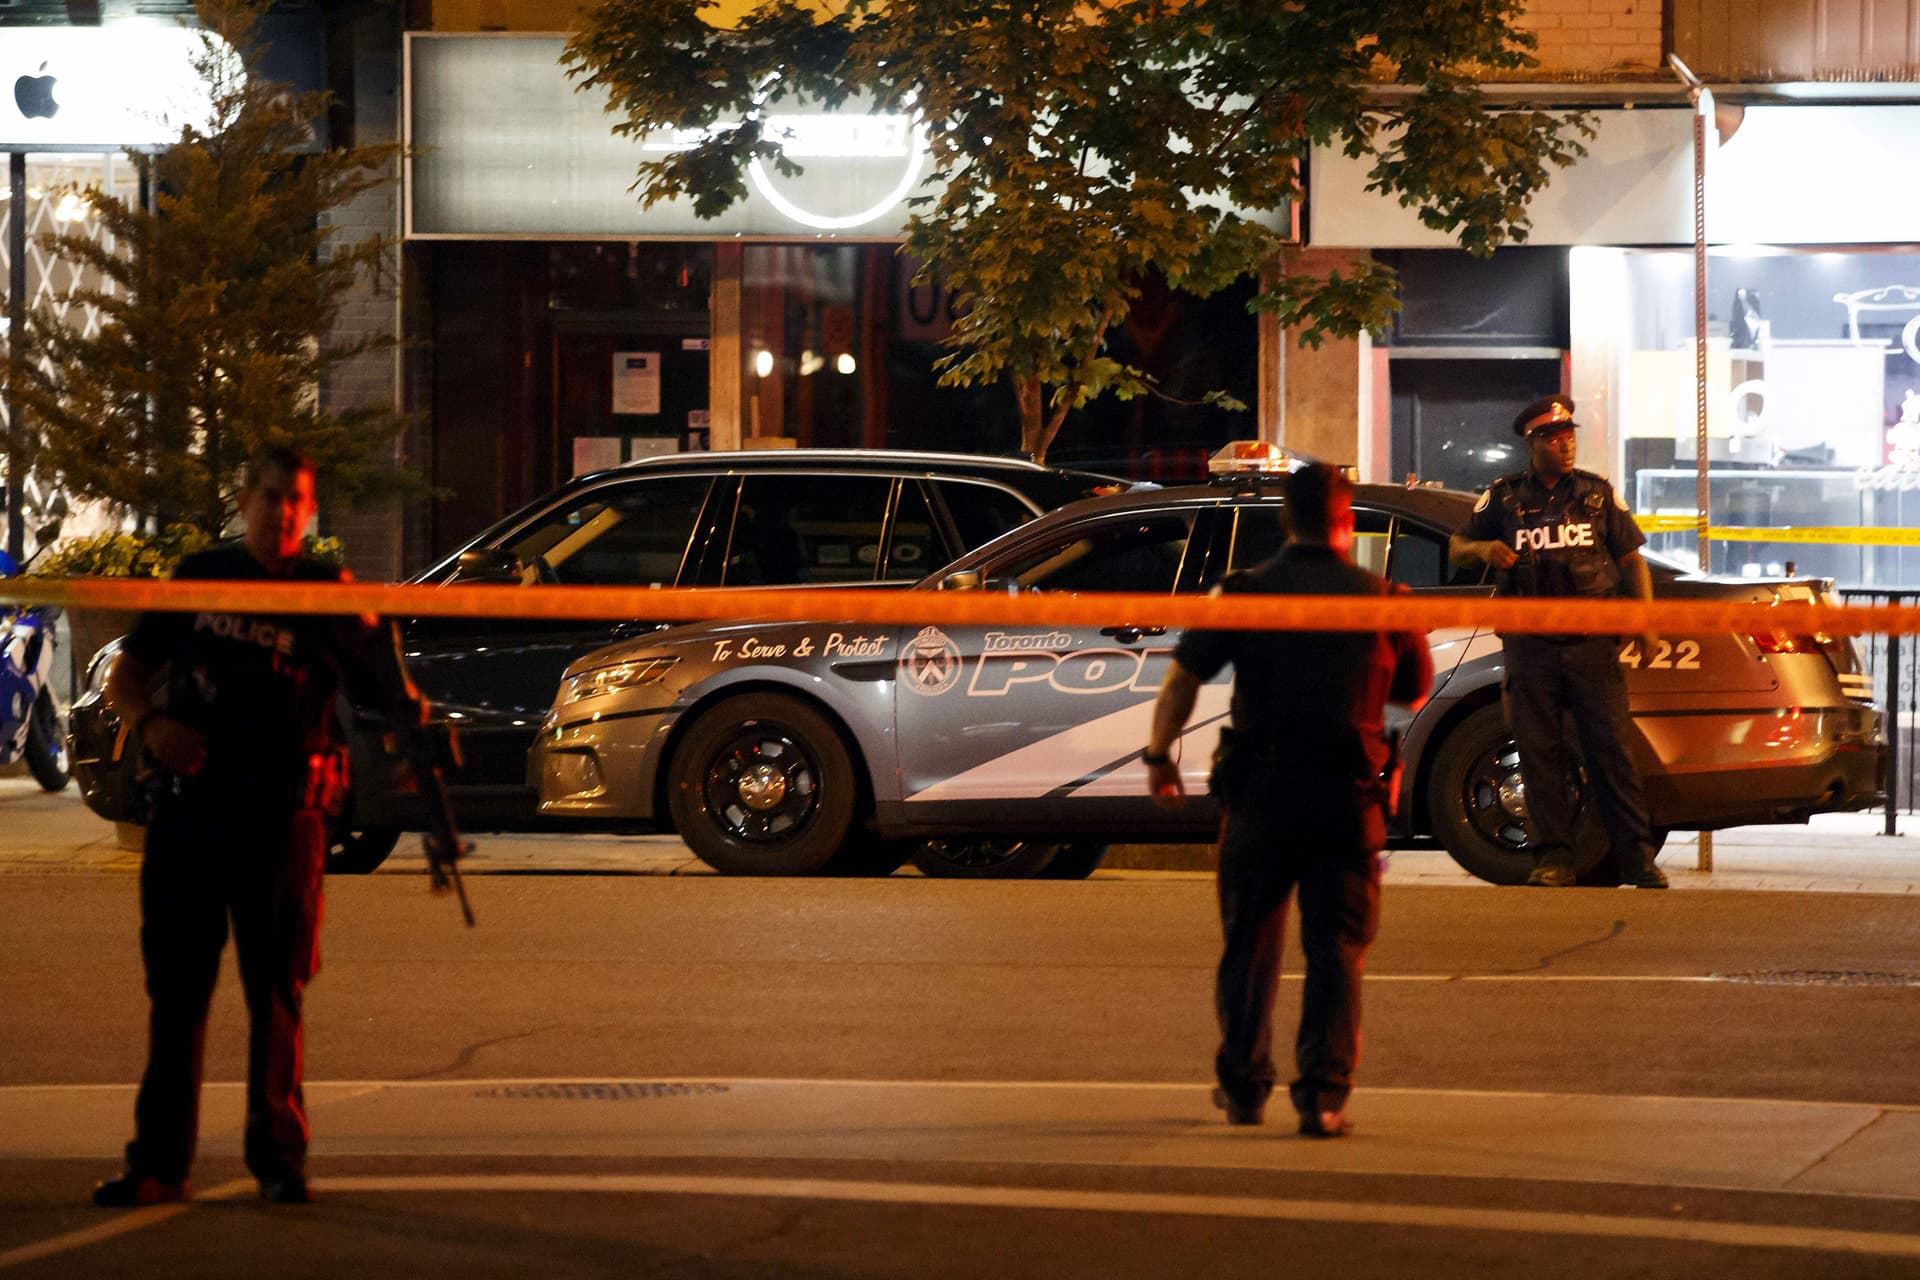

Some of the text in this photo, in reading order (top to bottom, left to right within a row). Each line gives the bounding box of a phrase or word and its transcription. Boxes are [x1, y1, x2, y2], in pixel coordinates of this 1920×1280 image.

[1515, 523, 1594, 551] POLICE
[194, 611, 293, 656] POLICE
[712, 640, 732, 662] To
[737, 637, 787, 659] Serve
[793, 637, 815, 657] &
[823, 632, 890, 657] Protect
[983, 631, 1072, 650] Toronto
[1619, 640, 1701, 669] 422
